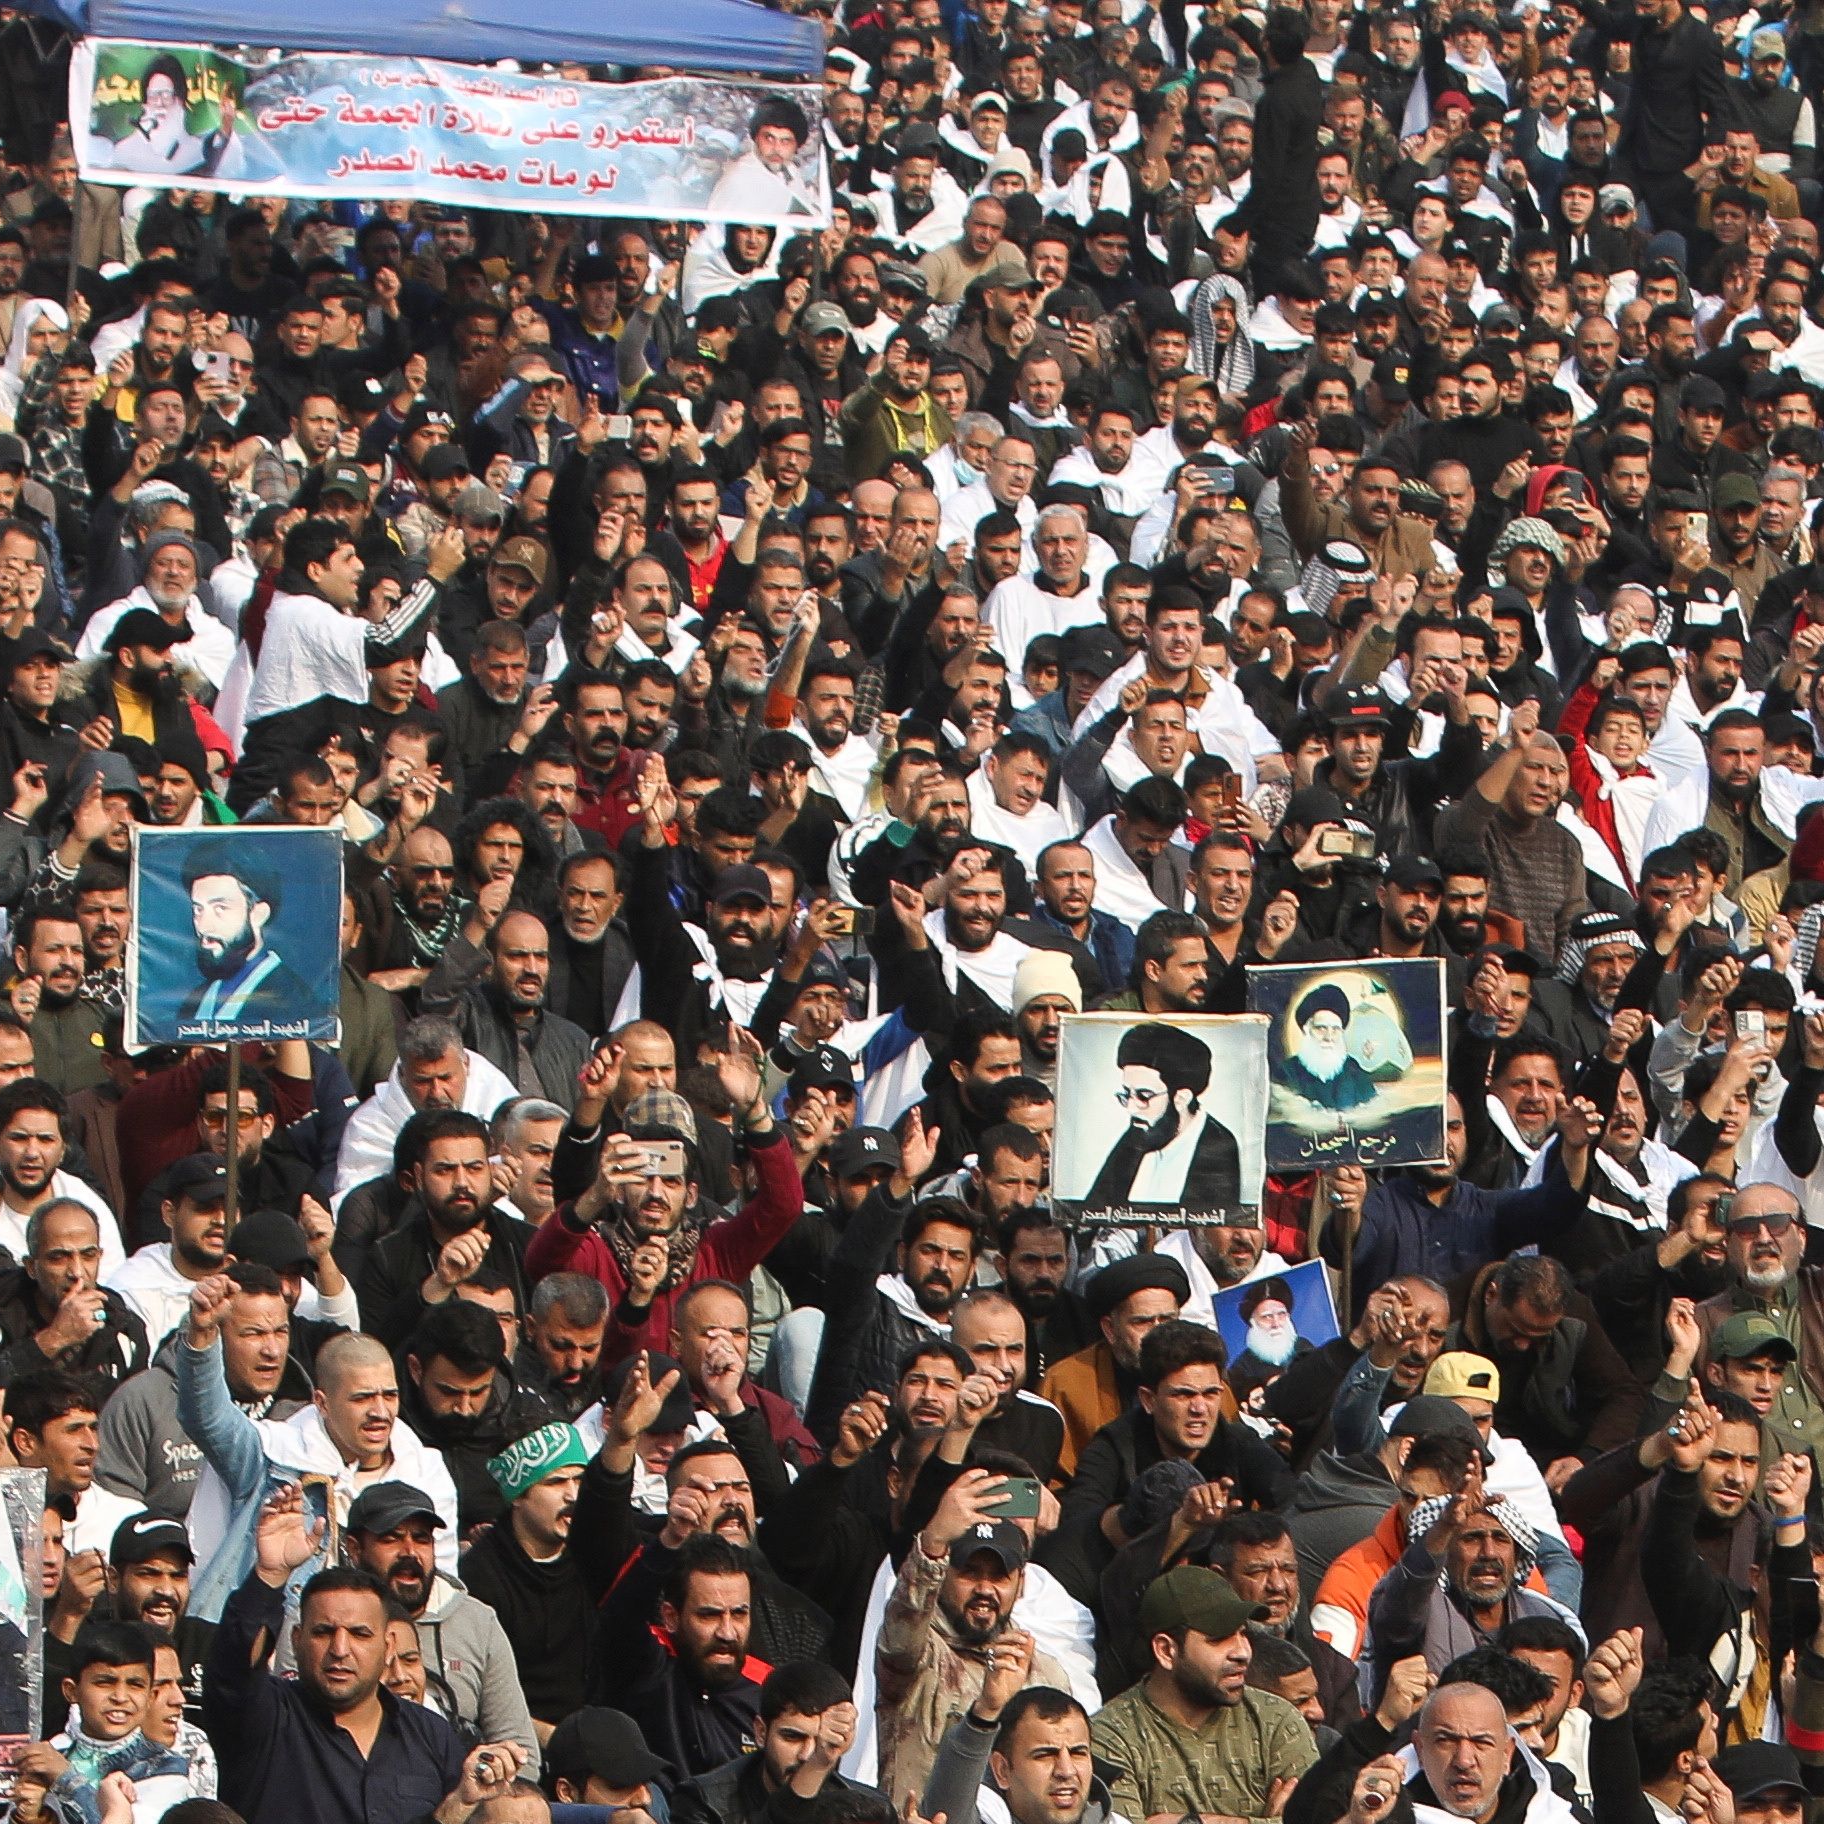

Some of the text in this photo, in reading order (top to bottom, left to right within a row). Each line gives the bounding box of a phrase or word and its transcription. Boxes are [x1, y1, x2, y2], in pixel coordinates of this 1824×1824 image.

[257, 98, 329, 132] حتى
[338, 98, 435, 131] الجمعة
[521, 120, 580, 144] على
[327, 147, 618, 195] لو مات محمد الصدر
